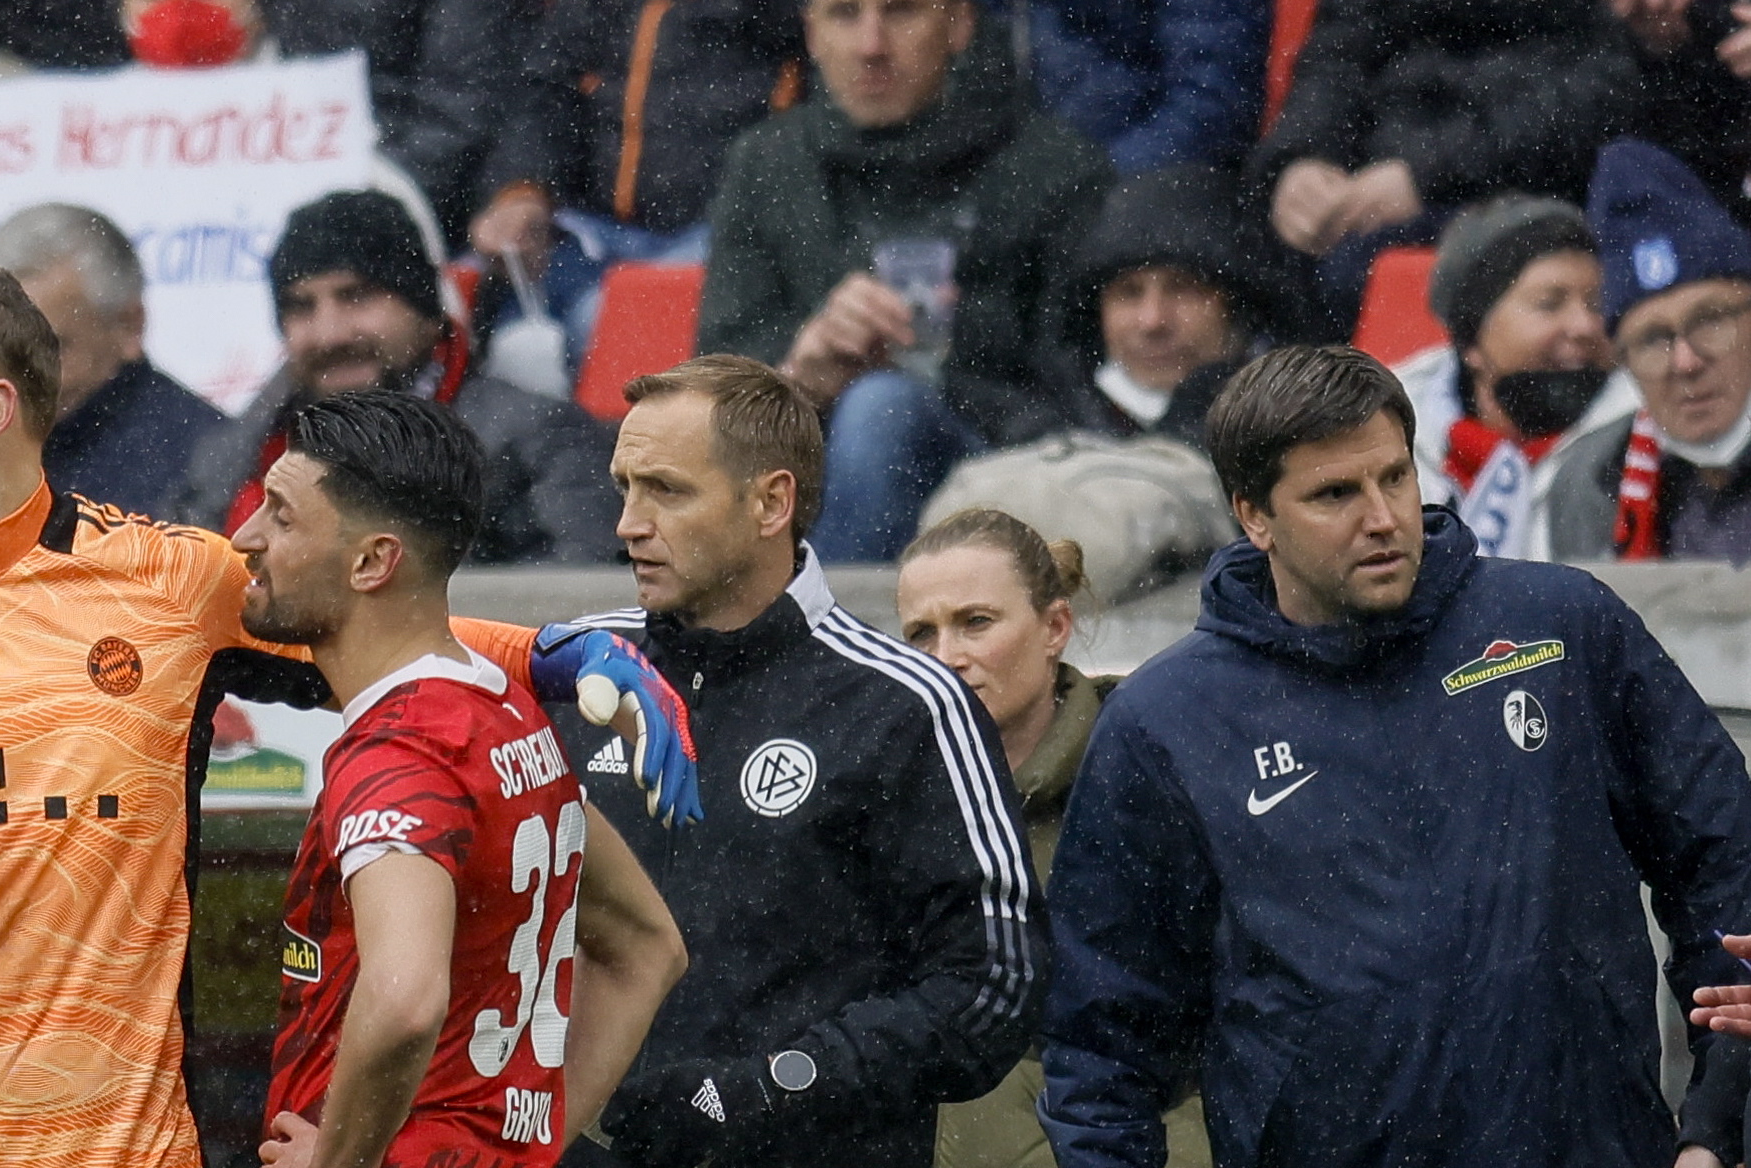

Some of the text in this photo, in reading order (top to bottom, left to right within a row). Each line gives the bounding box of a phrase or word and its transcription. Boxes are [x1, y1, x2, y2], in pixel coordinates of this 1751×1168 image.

[1446, 642, 1562, 691] Schwarzwaldmilch
[489, 747, 523, 799] SC
[587, 758, 629, 774] adidas
[1254, 741, 1304, 780] F.B.
[335, 809, 423, 857] ROSE
